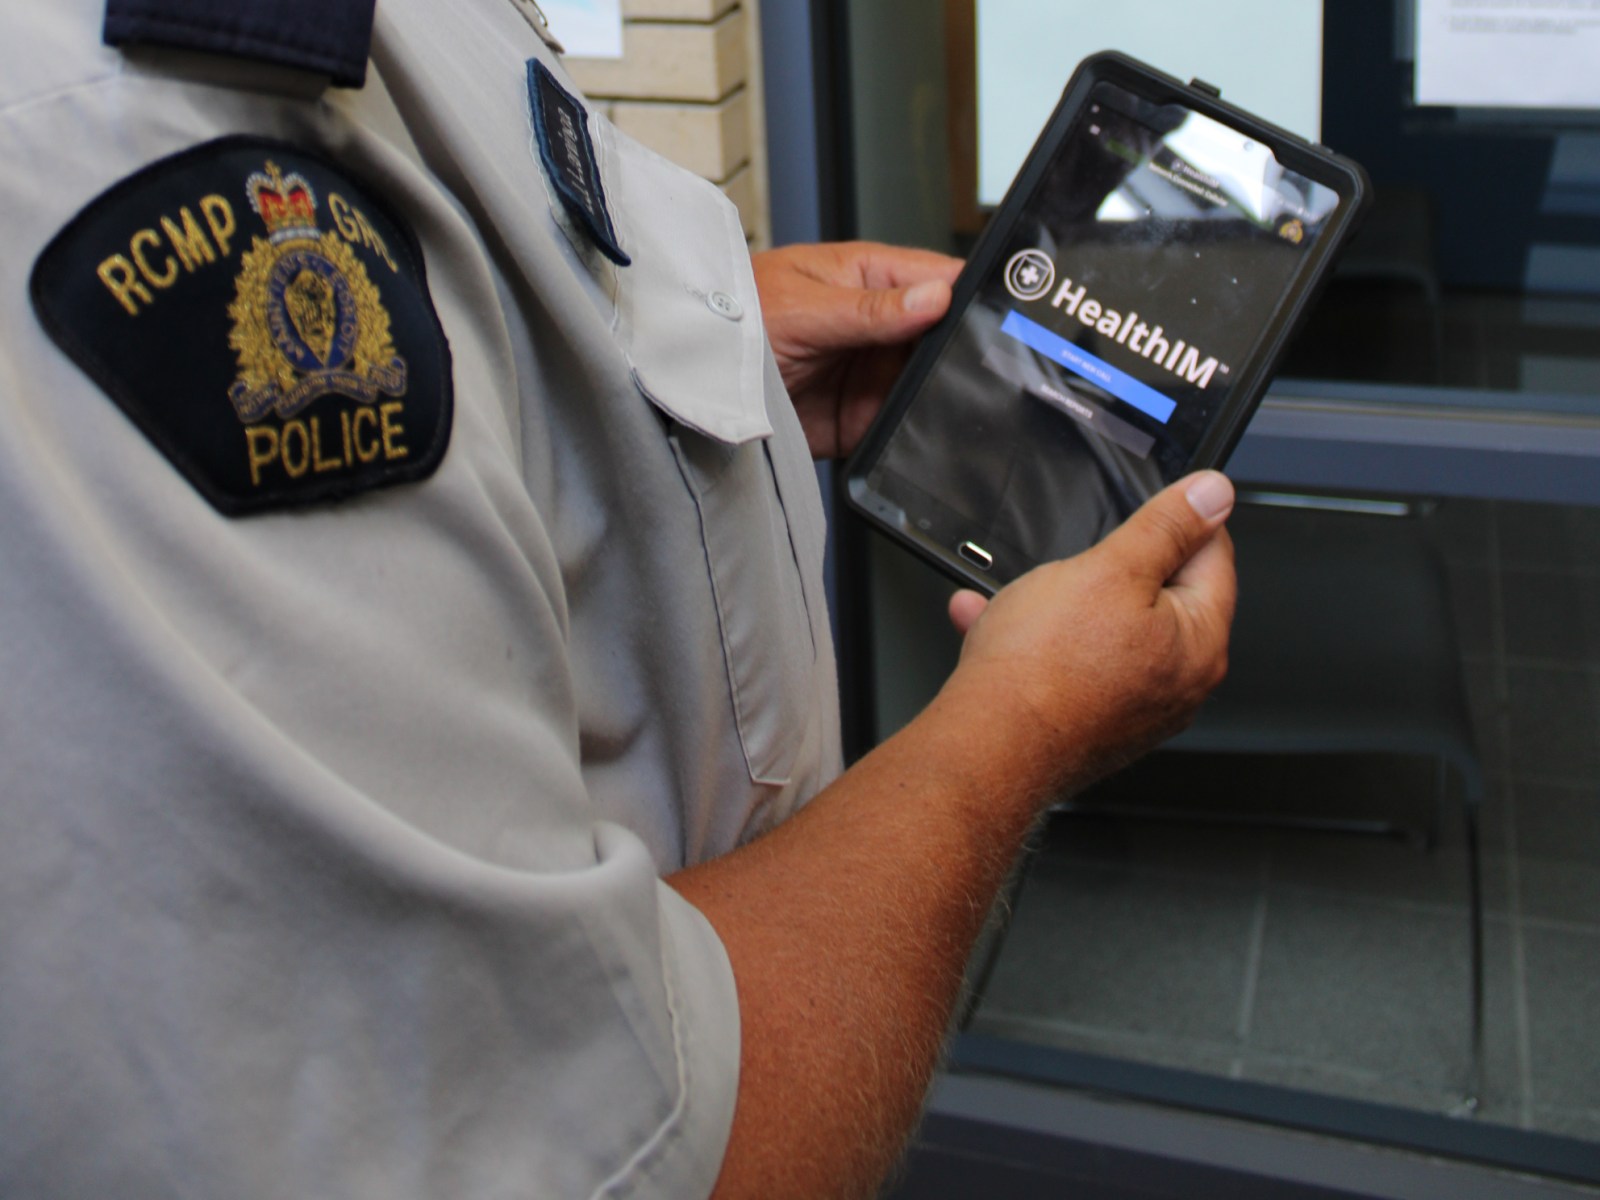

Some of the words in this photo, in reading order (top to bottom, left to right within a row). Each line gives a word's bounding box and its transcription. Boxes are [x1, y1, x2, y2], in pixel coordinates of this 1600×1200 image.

[97, 193, 237, 317] RCMP
[1050, 277, 1219, 389] HealthIM
[245, 402, 409, 486] POLICE
